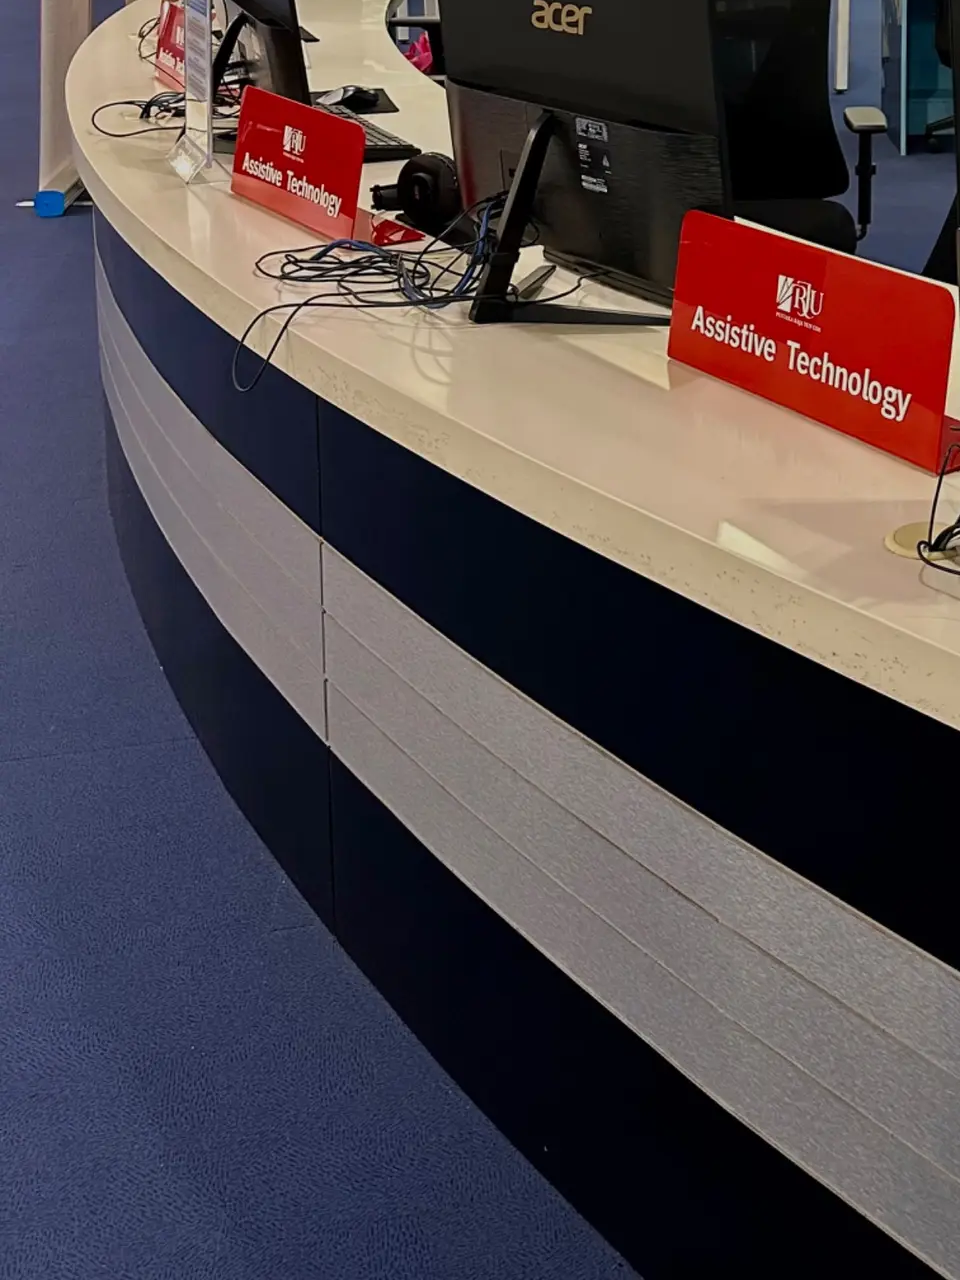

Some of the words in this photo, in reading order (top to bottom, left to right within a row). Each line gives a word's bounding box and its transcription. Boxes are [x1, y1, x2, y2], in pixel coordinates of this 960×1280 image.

[531, 0, 592, 35] acer
[242, 152, 283, 187] Assistive
[286, 170, 342, 218] Technology
[691, 305, 777, 362] Assistive
[787, 340, 912, 422] Technology
